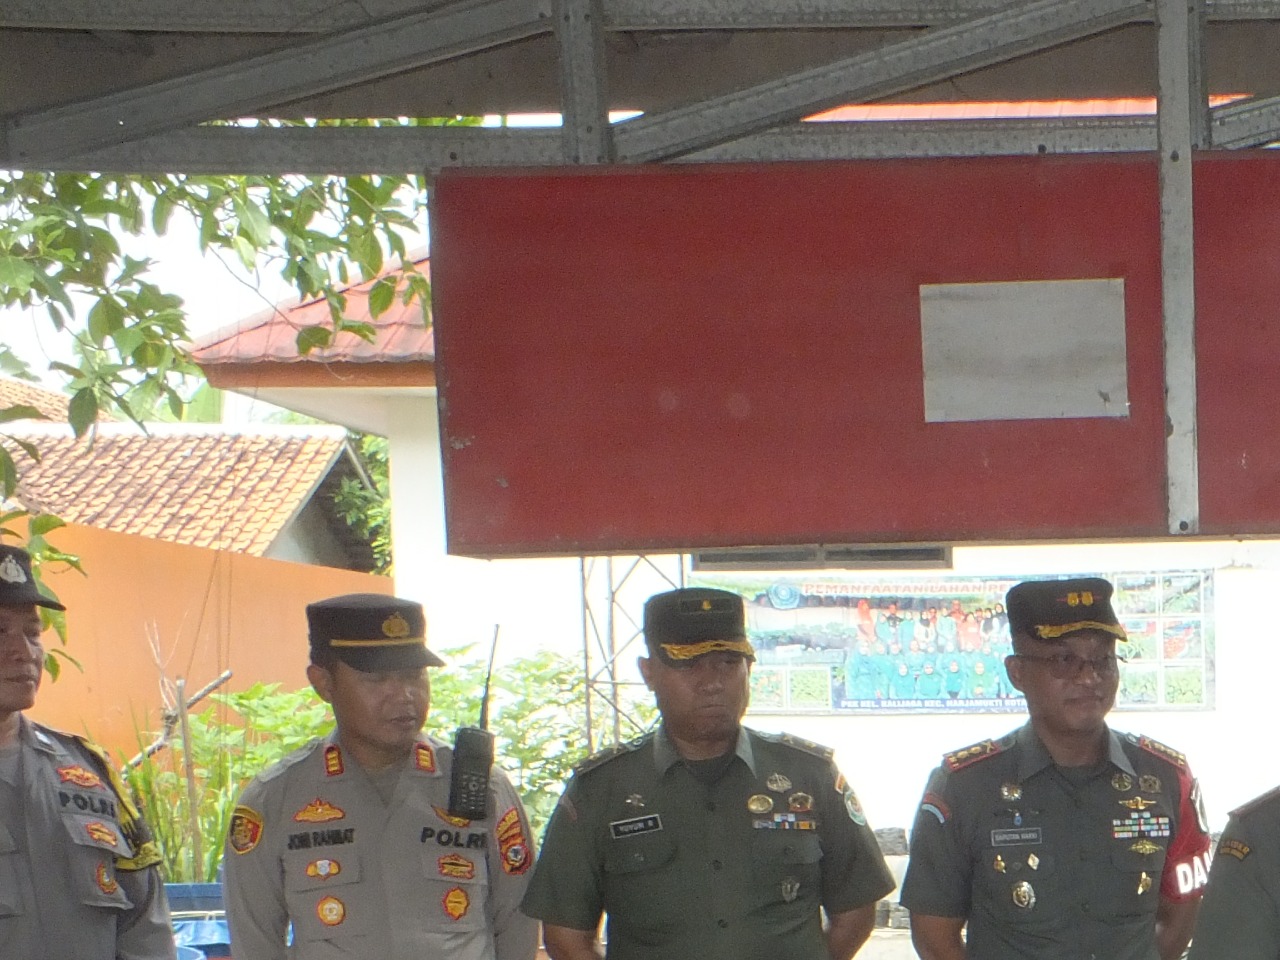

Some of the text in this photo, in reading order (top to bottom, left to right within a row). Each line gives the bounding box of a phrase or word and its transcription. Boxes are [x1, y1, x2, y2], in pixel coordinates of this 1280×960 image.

[804, 583, 923, 594] PEMANFAATAN
[58, 791, 115, 818] POLRI
[421, 826, 489, 849] POLRI
